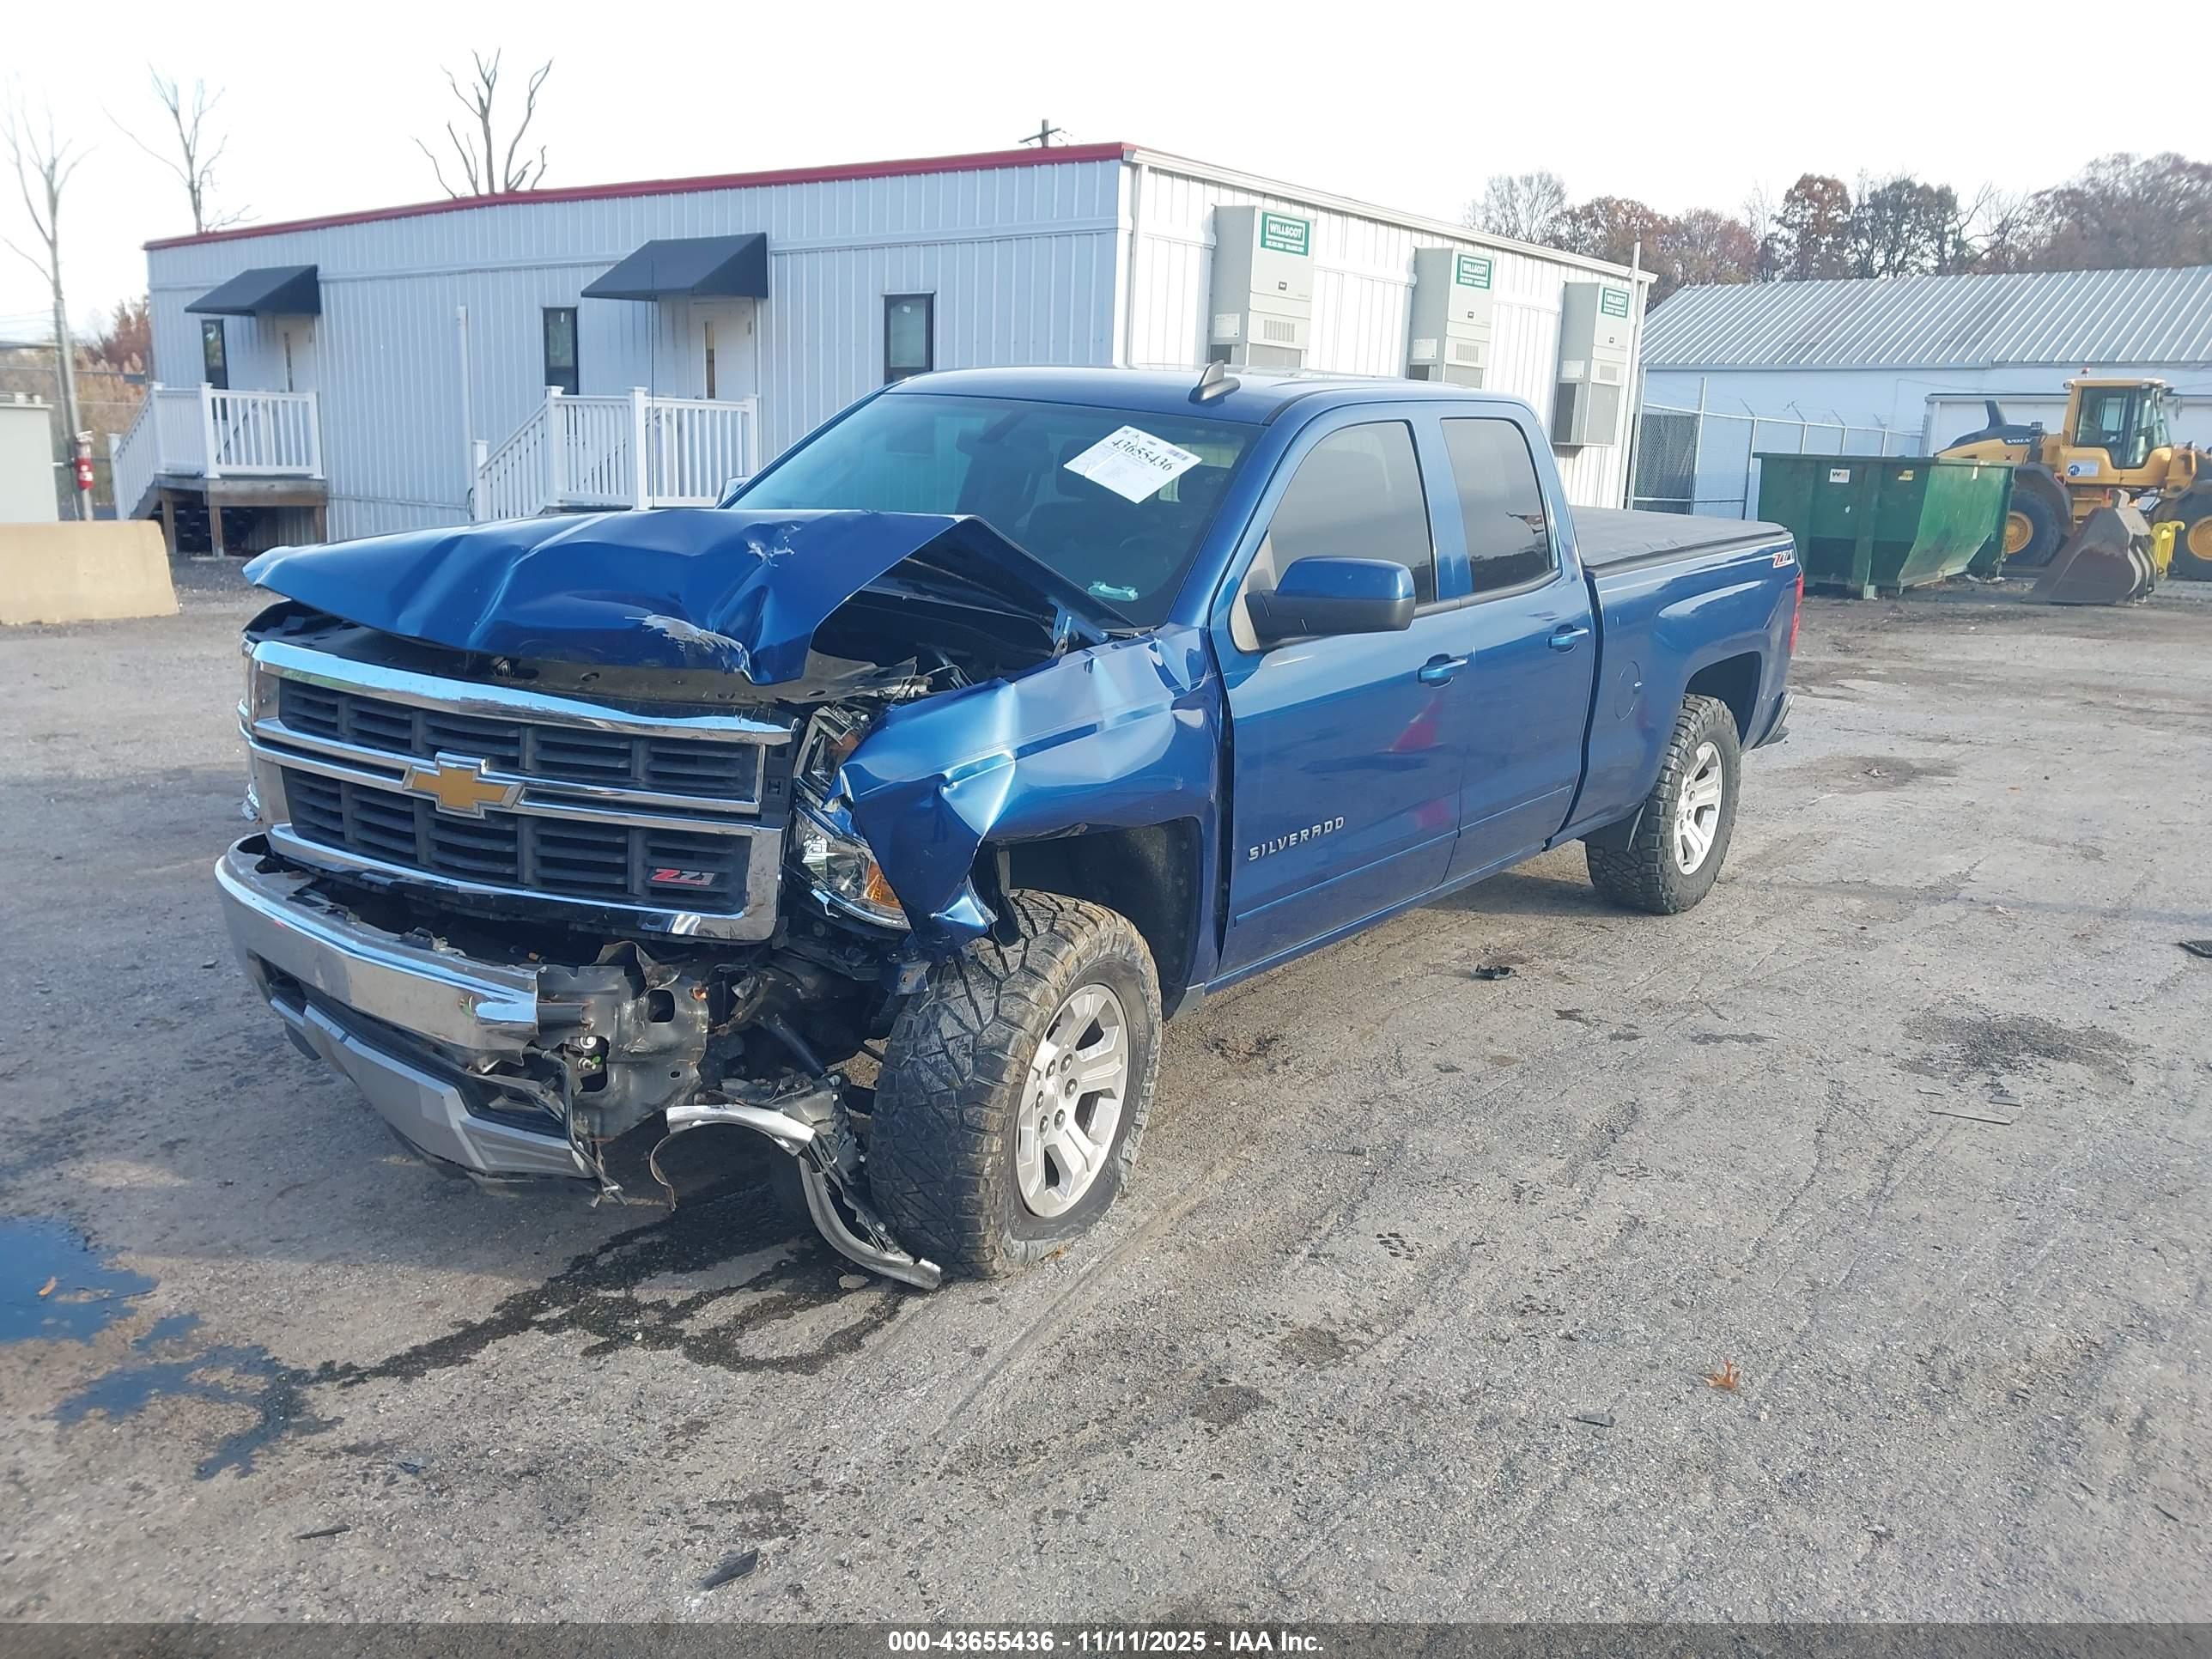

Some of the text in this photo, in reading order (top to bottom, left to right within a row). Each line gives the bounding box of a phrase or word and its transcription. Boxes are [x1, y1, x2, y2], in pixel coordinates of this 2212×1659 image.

[1111, 439, 1176, 471] 43655436
[1772, 550, 1795, 568] Z71
[1249, 817, 1344, 861] SILVERADO
[652, 868, 715, 885] Z71
